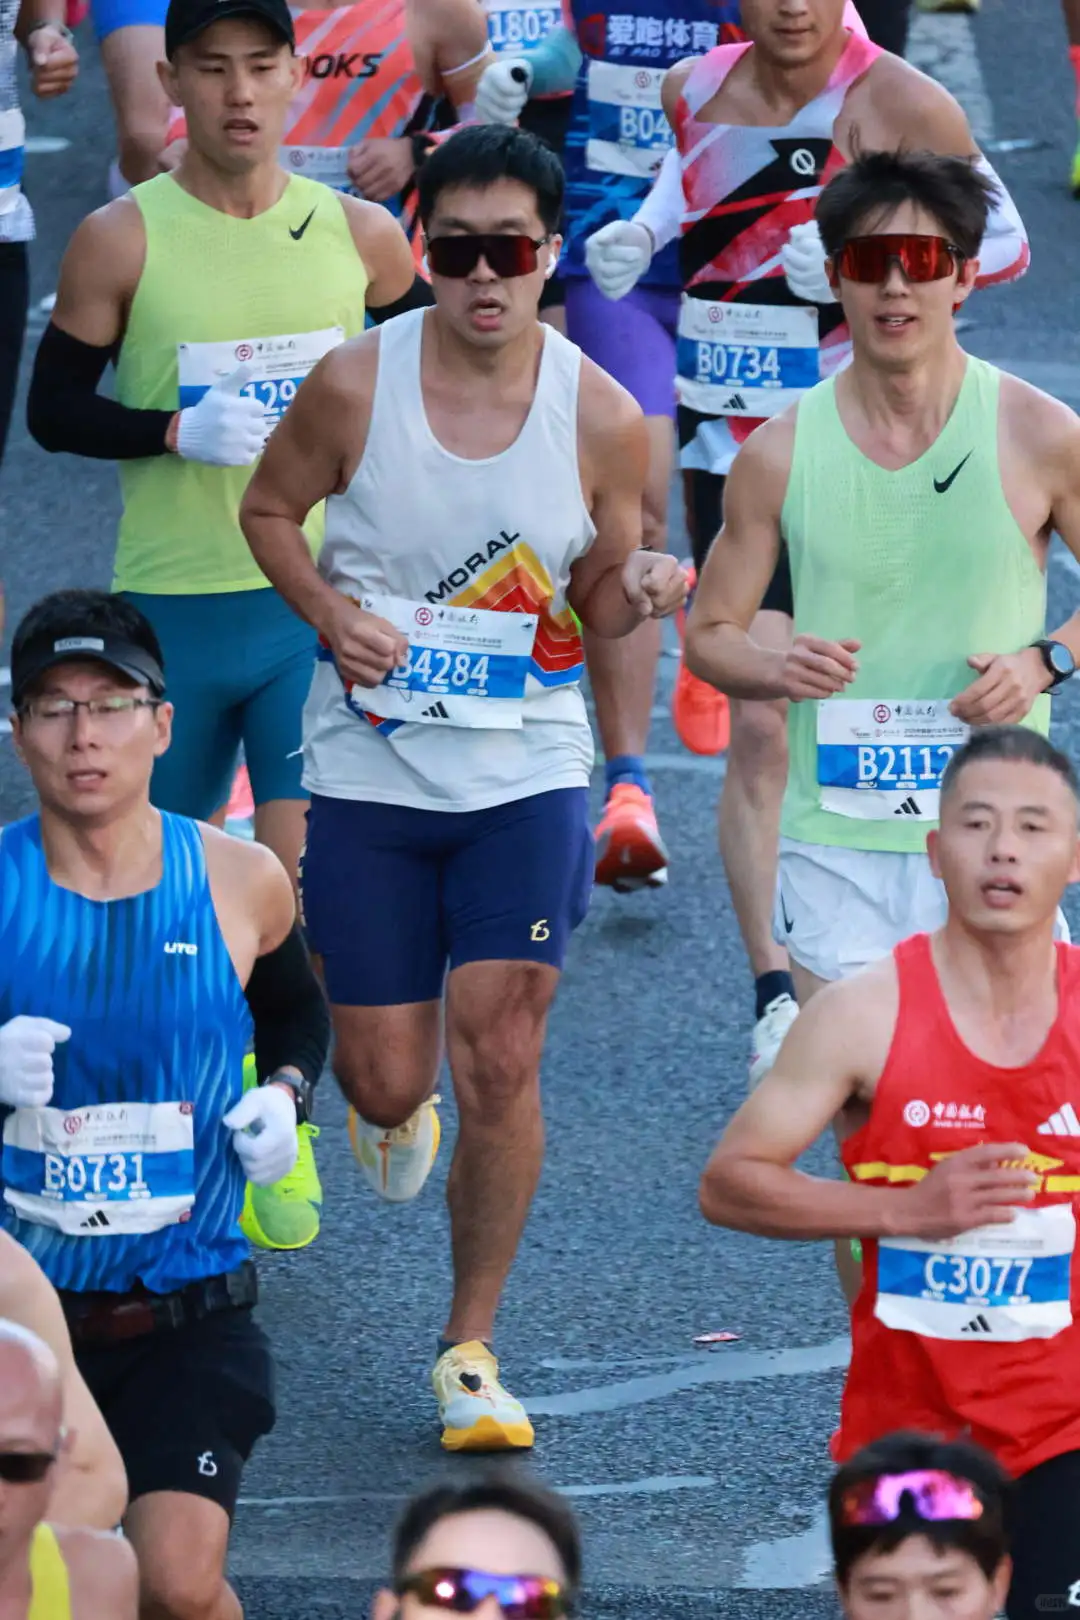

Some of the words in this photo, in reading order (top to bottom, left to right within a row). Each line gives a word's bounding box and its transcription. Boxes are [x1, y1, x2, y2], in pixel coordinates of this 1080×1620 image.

[608, 14, 719, 52] 爱跑体育
[306, 53, 382, 78] OKS
[697, 342, 781, 380] B0734
[424, 530, 520, 604] MORAL
[392, 647, 490, 688] B4284
[858, 745, 954, 781] B2112
[45, 1154, 147, 1193] B0731
[925, 1254, 1033, 1296] C3077
